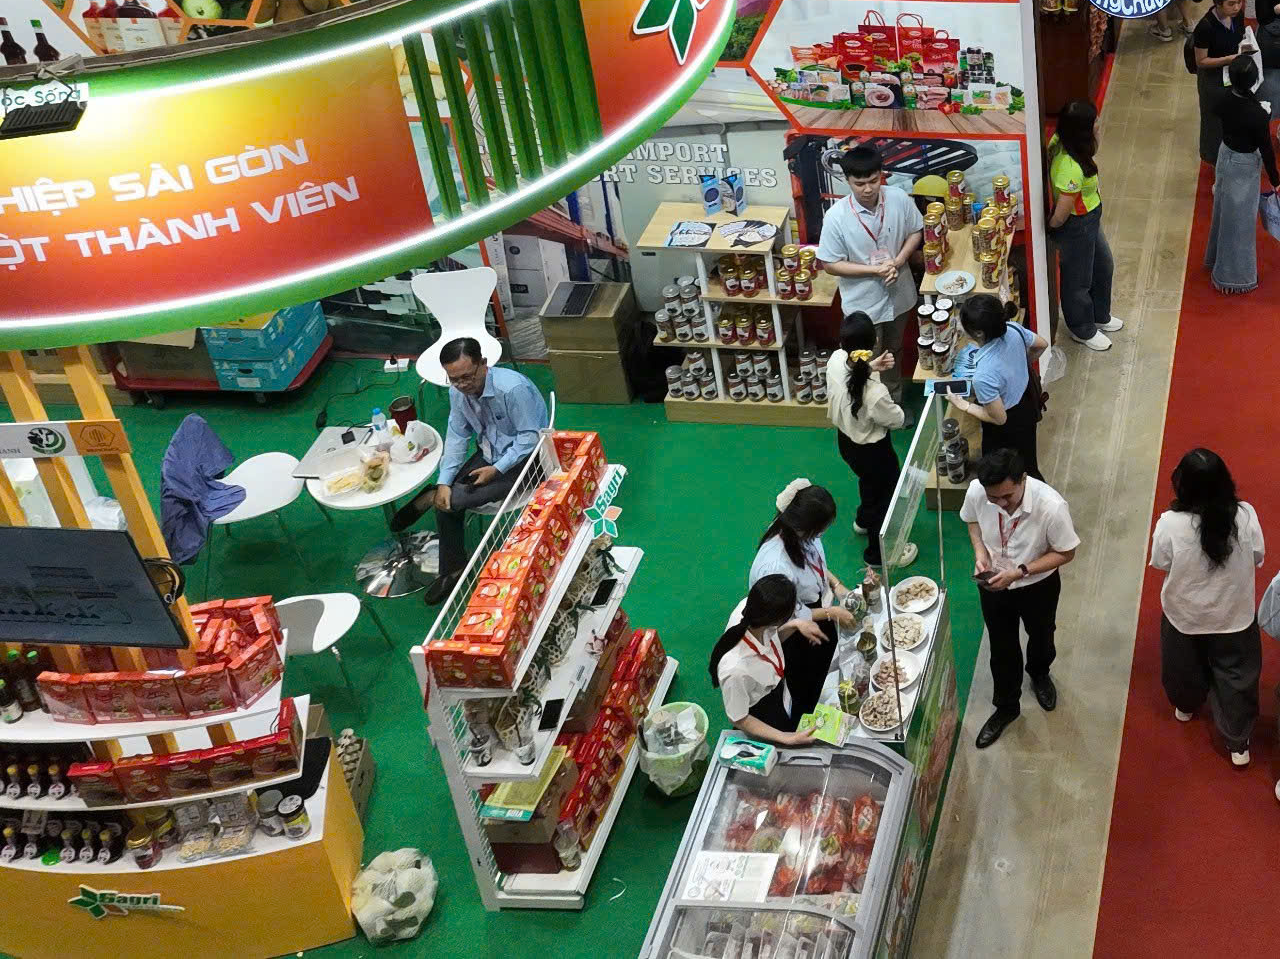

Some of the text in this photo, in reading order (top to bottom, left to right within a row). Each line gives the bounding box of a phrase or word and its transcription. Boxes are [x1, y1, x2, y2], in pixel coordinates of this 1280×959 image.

[0, 138, 309, 216] HIỆP SÀI GÒN
[0, 175, 361, 271] ỘT THÀNH VIÊN
